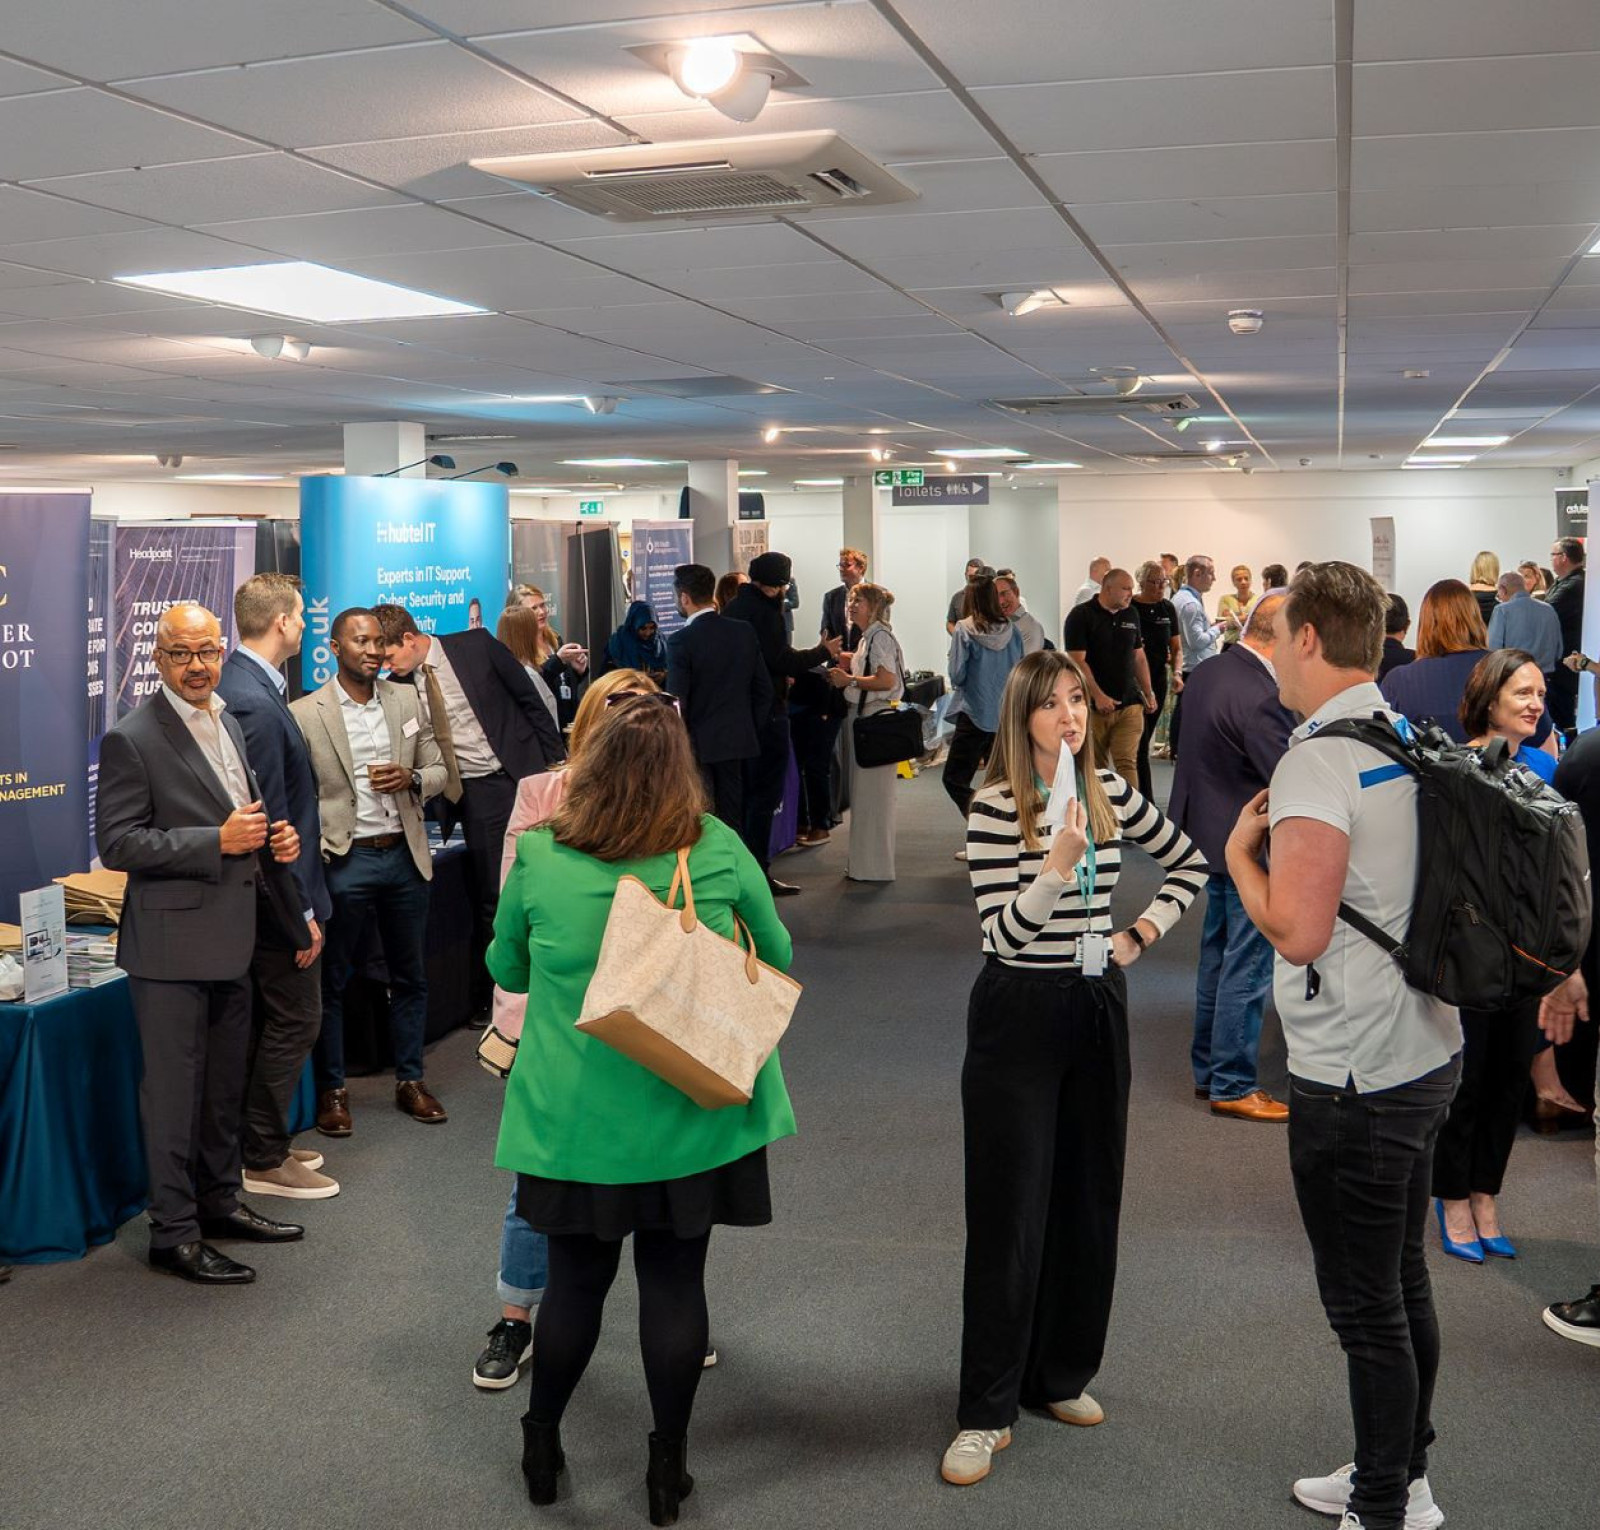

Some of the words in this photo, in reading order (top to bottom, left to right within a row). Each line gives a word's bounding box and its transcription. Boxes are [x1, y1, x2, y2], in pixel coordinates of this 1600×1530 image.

[388, 522, 423, 543] hubtel
[425, 522, 436, 542] IT
[129, 547, 173, 561] Headpoint
[377, 567, 413, 588] Experts
[415, 566, 424, 582] in
[425, 565, 435, 581] IT
[435, 565, 472, 586] Support,
[409, 590, 447, 609] Security
[448, 588, 465, 605] and
[15, 771, 28, 784] IN
